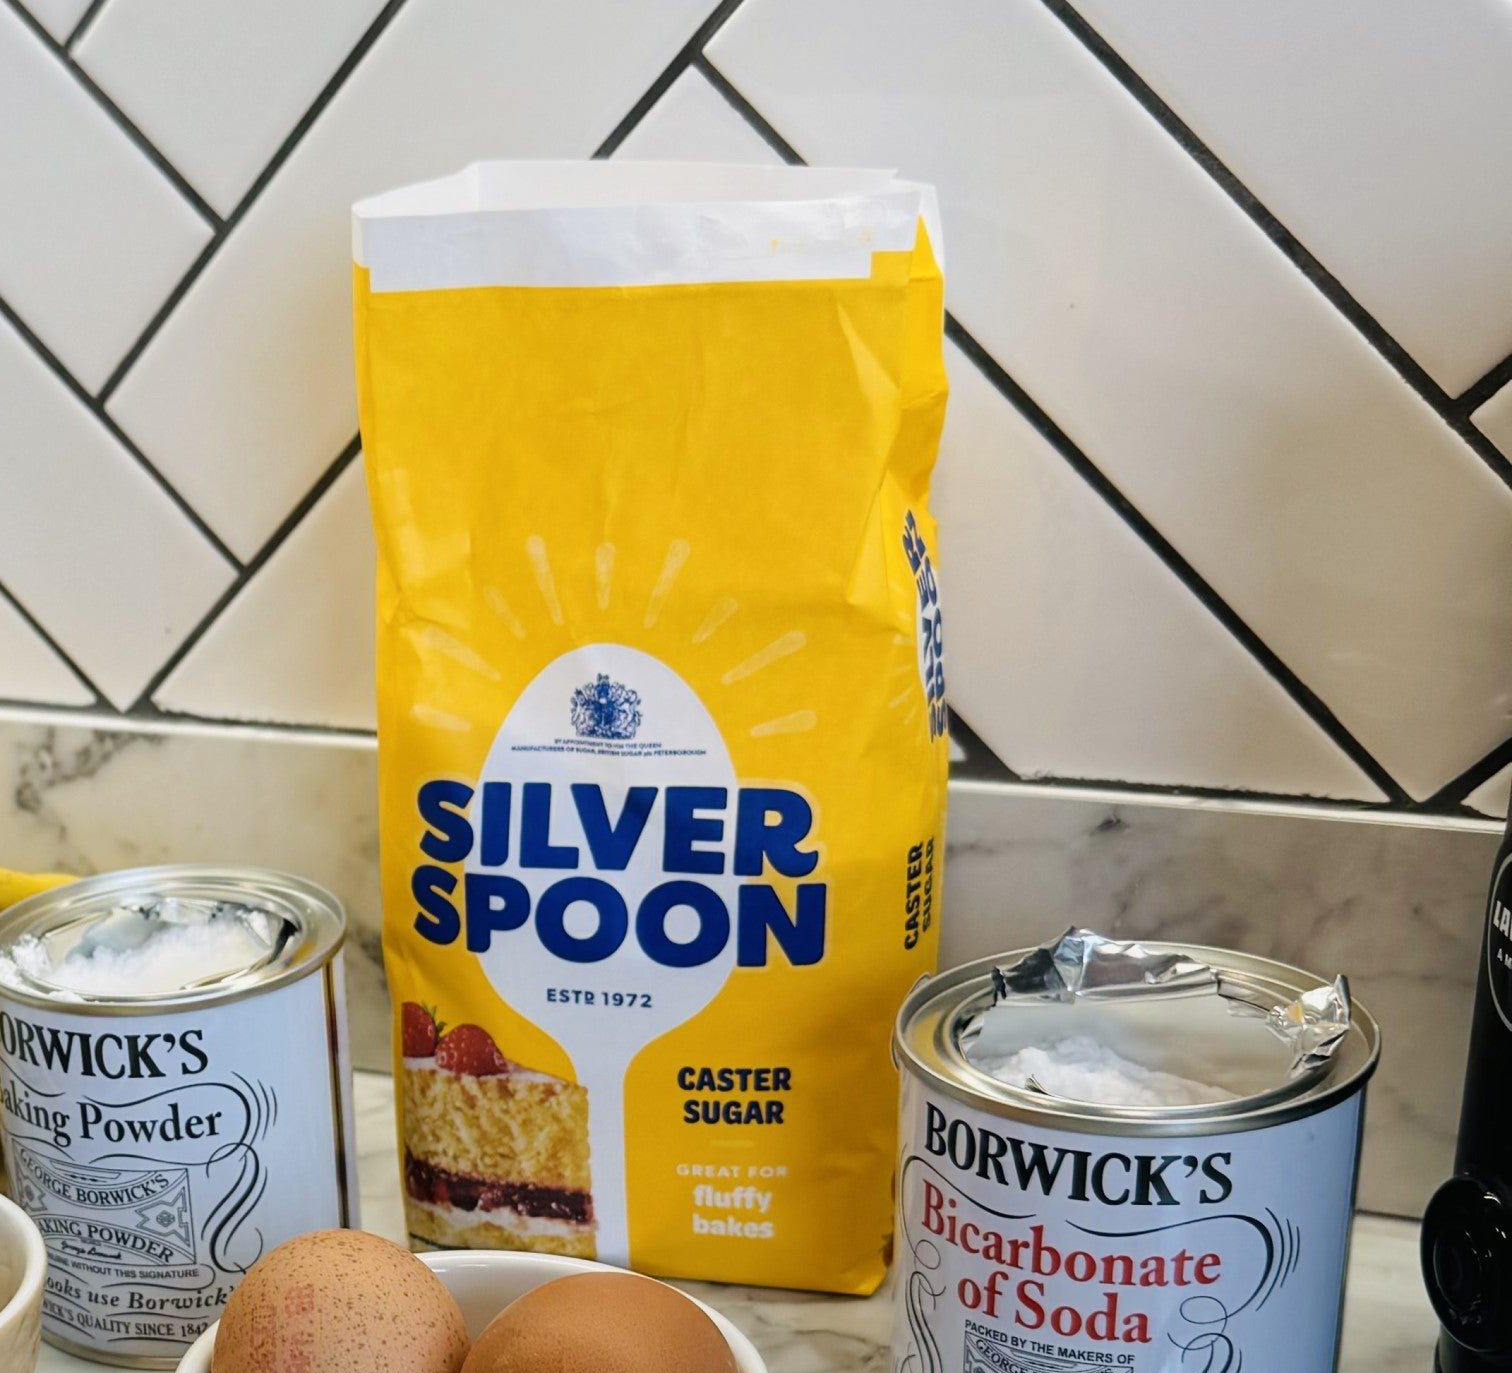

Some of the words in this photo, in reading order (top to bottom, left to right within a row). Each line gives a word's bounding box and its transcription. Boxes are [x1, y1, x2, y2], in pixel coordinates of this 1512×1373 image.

[902, 525, 936, 744] SILVER
[904, 508, 949, 738] SPOON
[511, 745, 565, 753] MANUFACTURERS
[566, 745, 575, 753] OF
[653, 749, 707, 757] PETERBOROUGH
[625, 742, 637, 750] THE
[638, 742, 662, 750] QUEEN
[417, 779, 819, 878] SILVER
[904, 841, 923, 950] CASTER
[923, 836, 934, 933] SUGAR
[411, 865, 827, 969] SPOON
[601, 991, 653, 1009] 1972
[677, 1066, 792, 1092] CASTER
[76, 1101, 223, 1143] Powder
[683, 1099, 785, 1125] SUGAR
[676, 1163, 741, 1179] GREAT
[747, 1165, 788, 1179] FOR
[924, 1101, 1233, 1206] BORWICK'S
[20, 1148, 72, 1199] GEORGE
[76, 1174, 170, 1206] BORWICK'S
[693, 1184, 773, 1214] fluffy
[39, 1217, 82, 1237] AKING
[88, 1222, 174, 1264] POWDER
[692, 1213, 776, 1239] bakes
[920, 1179, 1222, 1288] Bicarbonate
[71, 1260, 112, 1277] WITHOUT
[115, 1268, 138, 1280] THIS
[138, 1267, 200, 1280] SIGNATURE
[46, 1276, 81, 1299] ooks
[88, 1290, 120, 1307] use
[128, 1285, 235, 1312] Borwick'
[957, 1269, 1009, 1319] of
[1014, 1275, 1153, 1345] Soda
[76, 1312, 132, 1336] QUALITY
[135, 1322, 176, 1337] SINCE
[964, 1319, 1008, 1344] PACKED
[1010, 1336, 1028, 1349] BY
[1029, 1340, 1055, 1356] THE
[1057, 1347, 1114, 1364] MAKERS
[1117, 1353, 1136, 1366] OF
